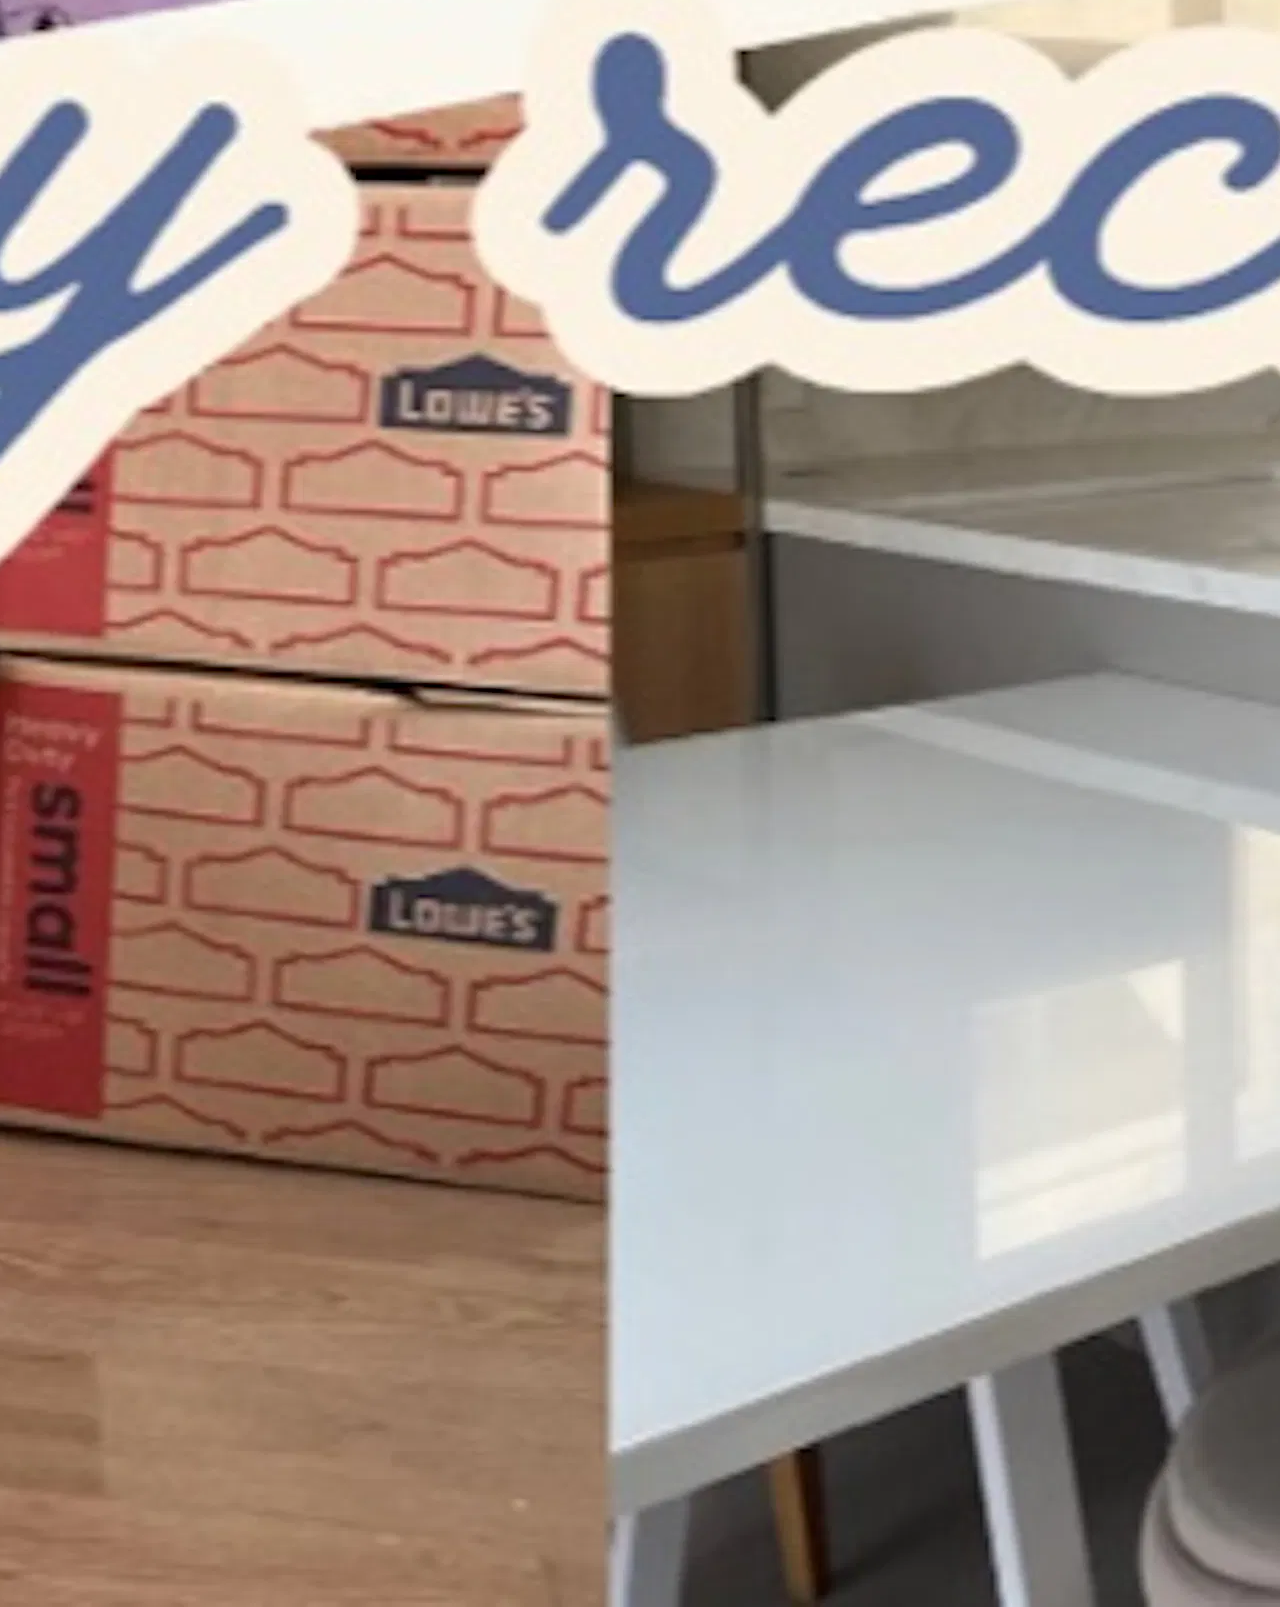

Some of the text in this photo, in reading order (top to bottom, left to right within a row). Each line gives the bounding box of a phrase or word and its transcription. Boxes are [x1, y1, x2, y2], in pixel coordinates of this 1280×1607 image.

[398, 379, 553, 431] LOWE'S
[24, 780, 93, 1000] small
[387, 890, 540, 942] LOWE'S
